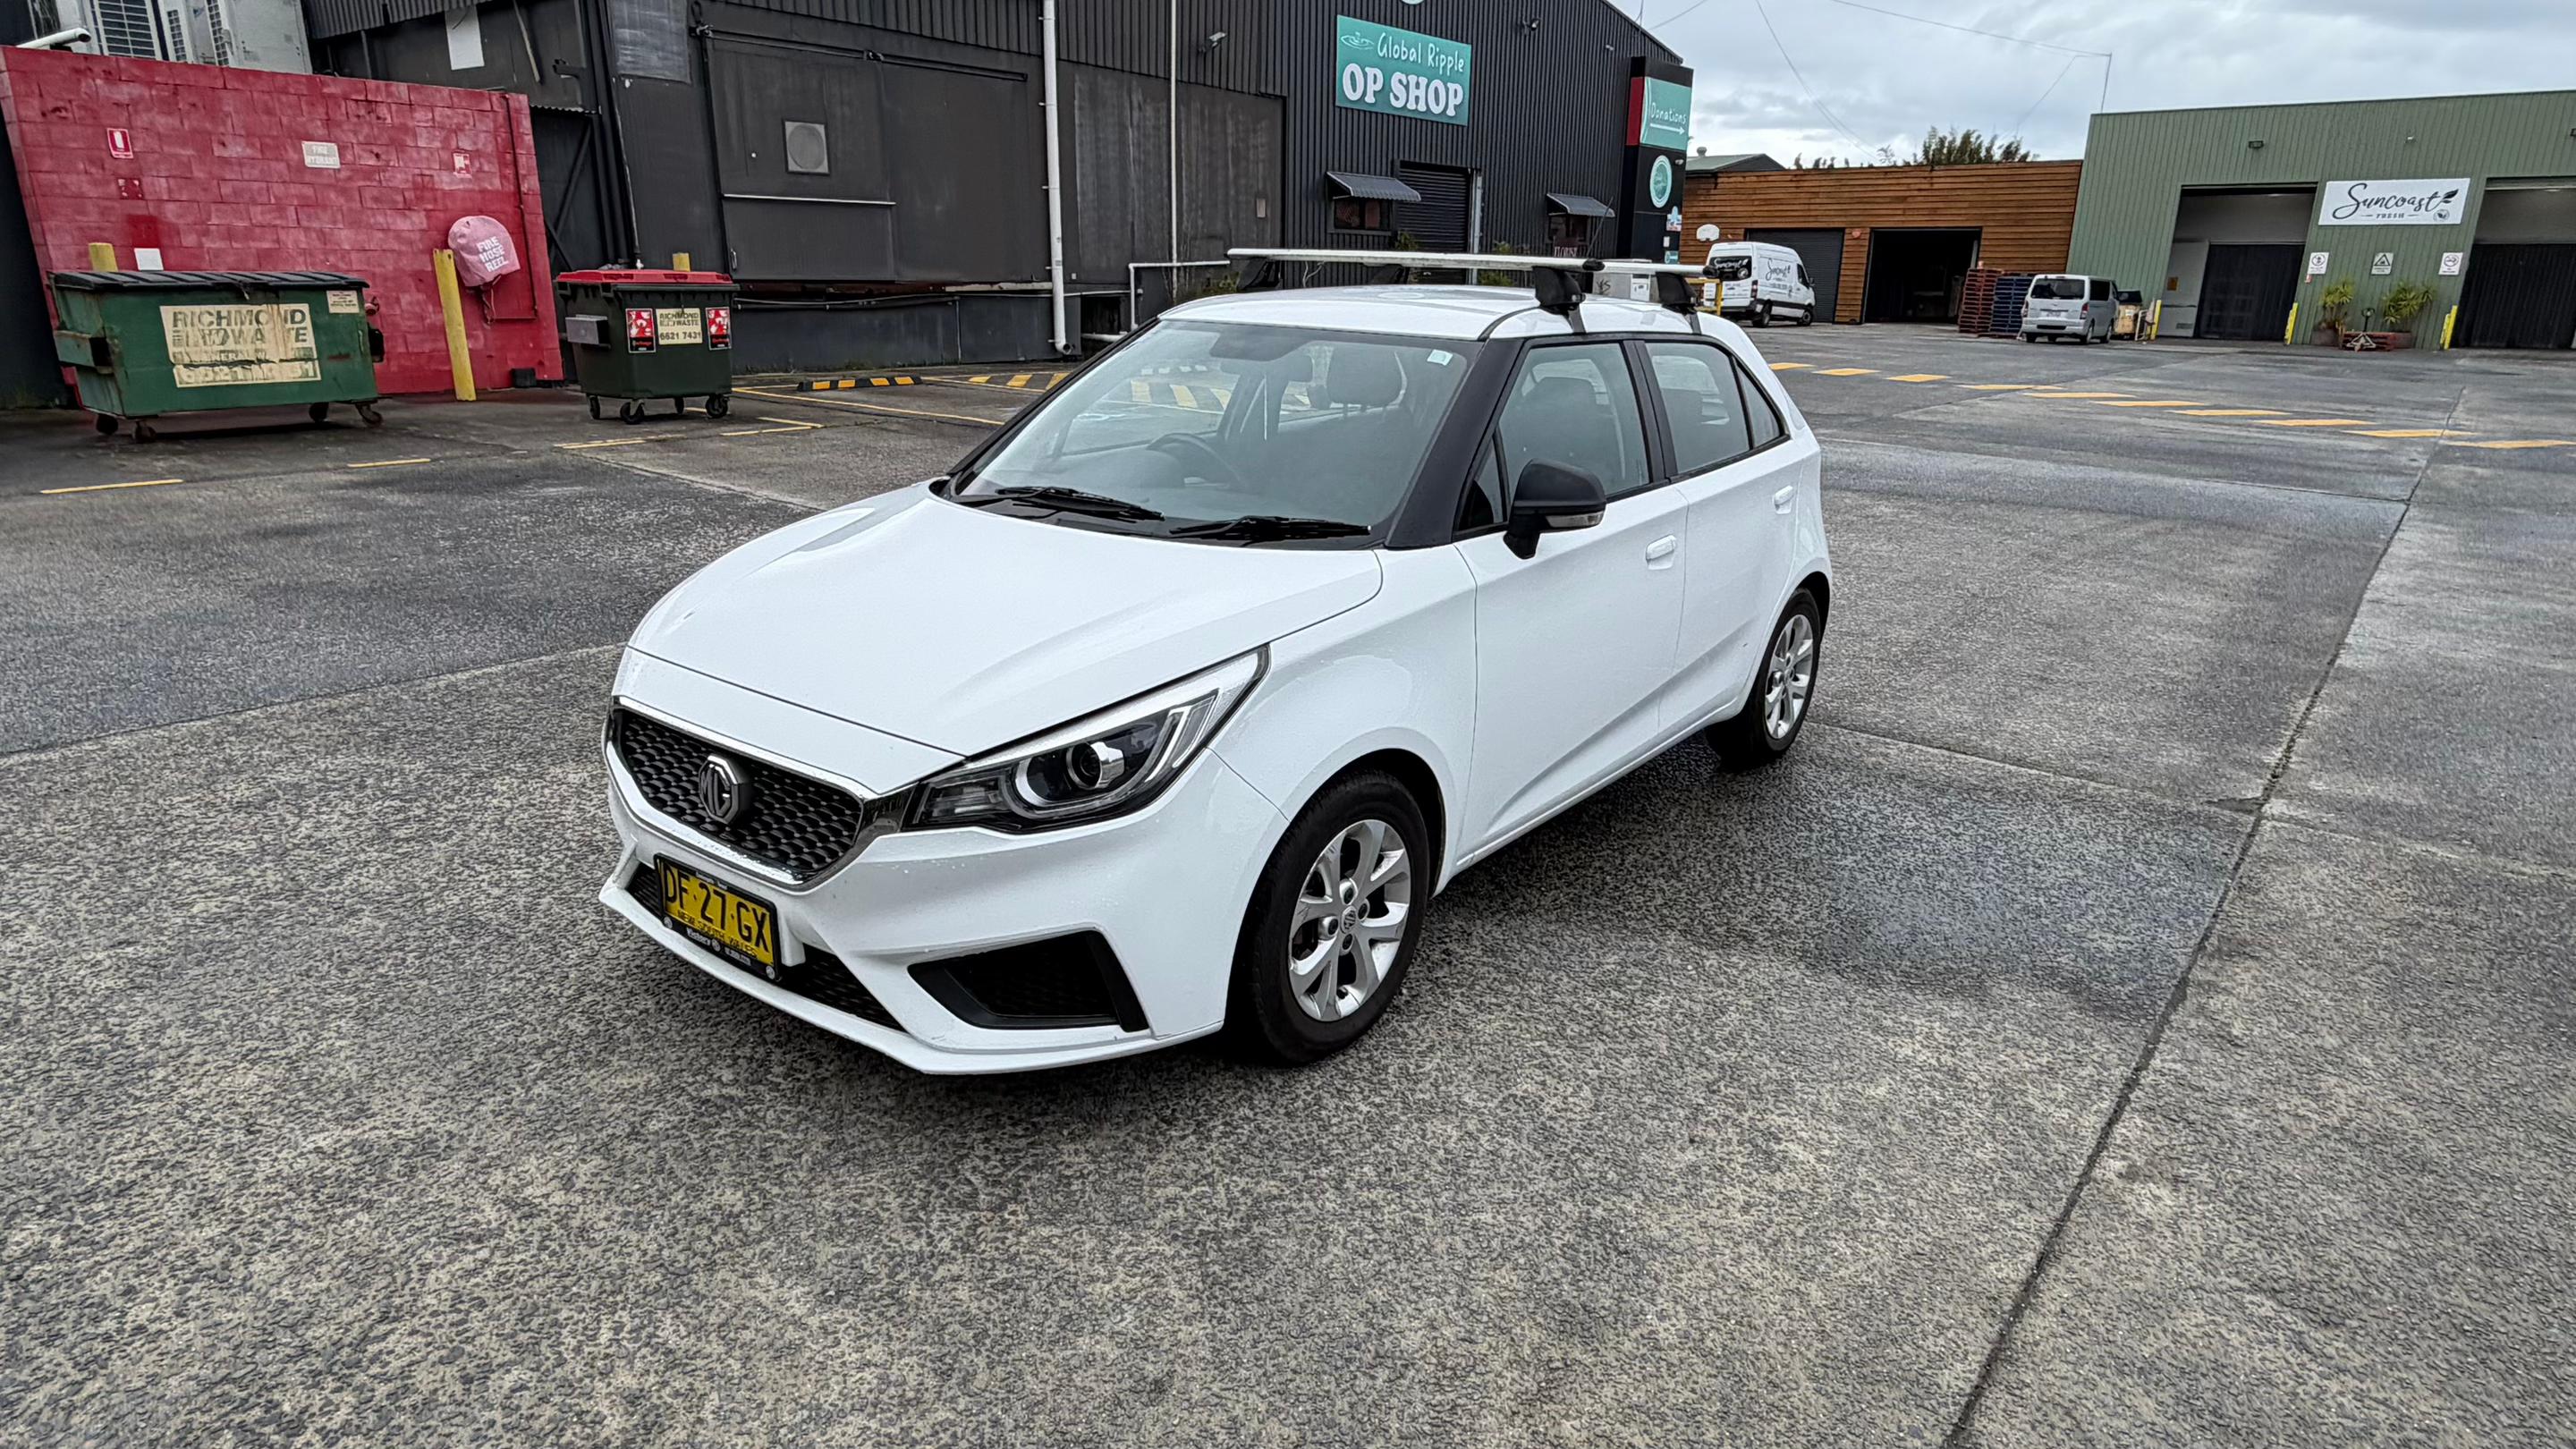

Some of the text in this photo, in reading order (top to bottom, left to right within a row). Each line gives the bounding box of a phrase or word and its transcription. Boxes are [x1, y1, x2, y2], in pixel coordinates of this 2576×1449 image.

[1377, 32, 1465, 76] Global Ripple
[1343, 63, 1464, 117] OP SHOP
[1650, 102, 1687, 124] Donations
[2332, 182, 2443, 220] Suncoast
[477, 236, 500, 252] FIRE
[479, 246, 505, 263] HOSE
[485, 257, 509, 272] REEL
[699, 760, 733, 818] MG
